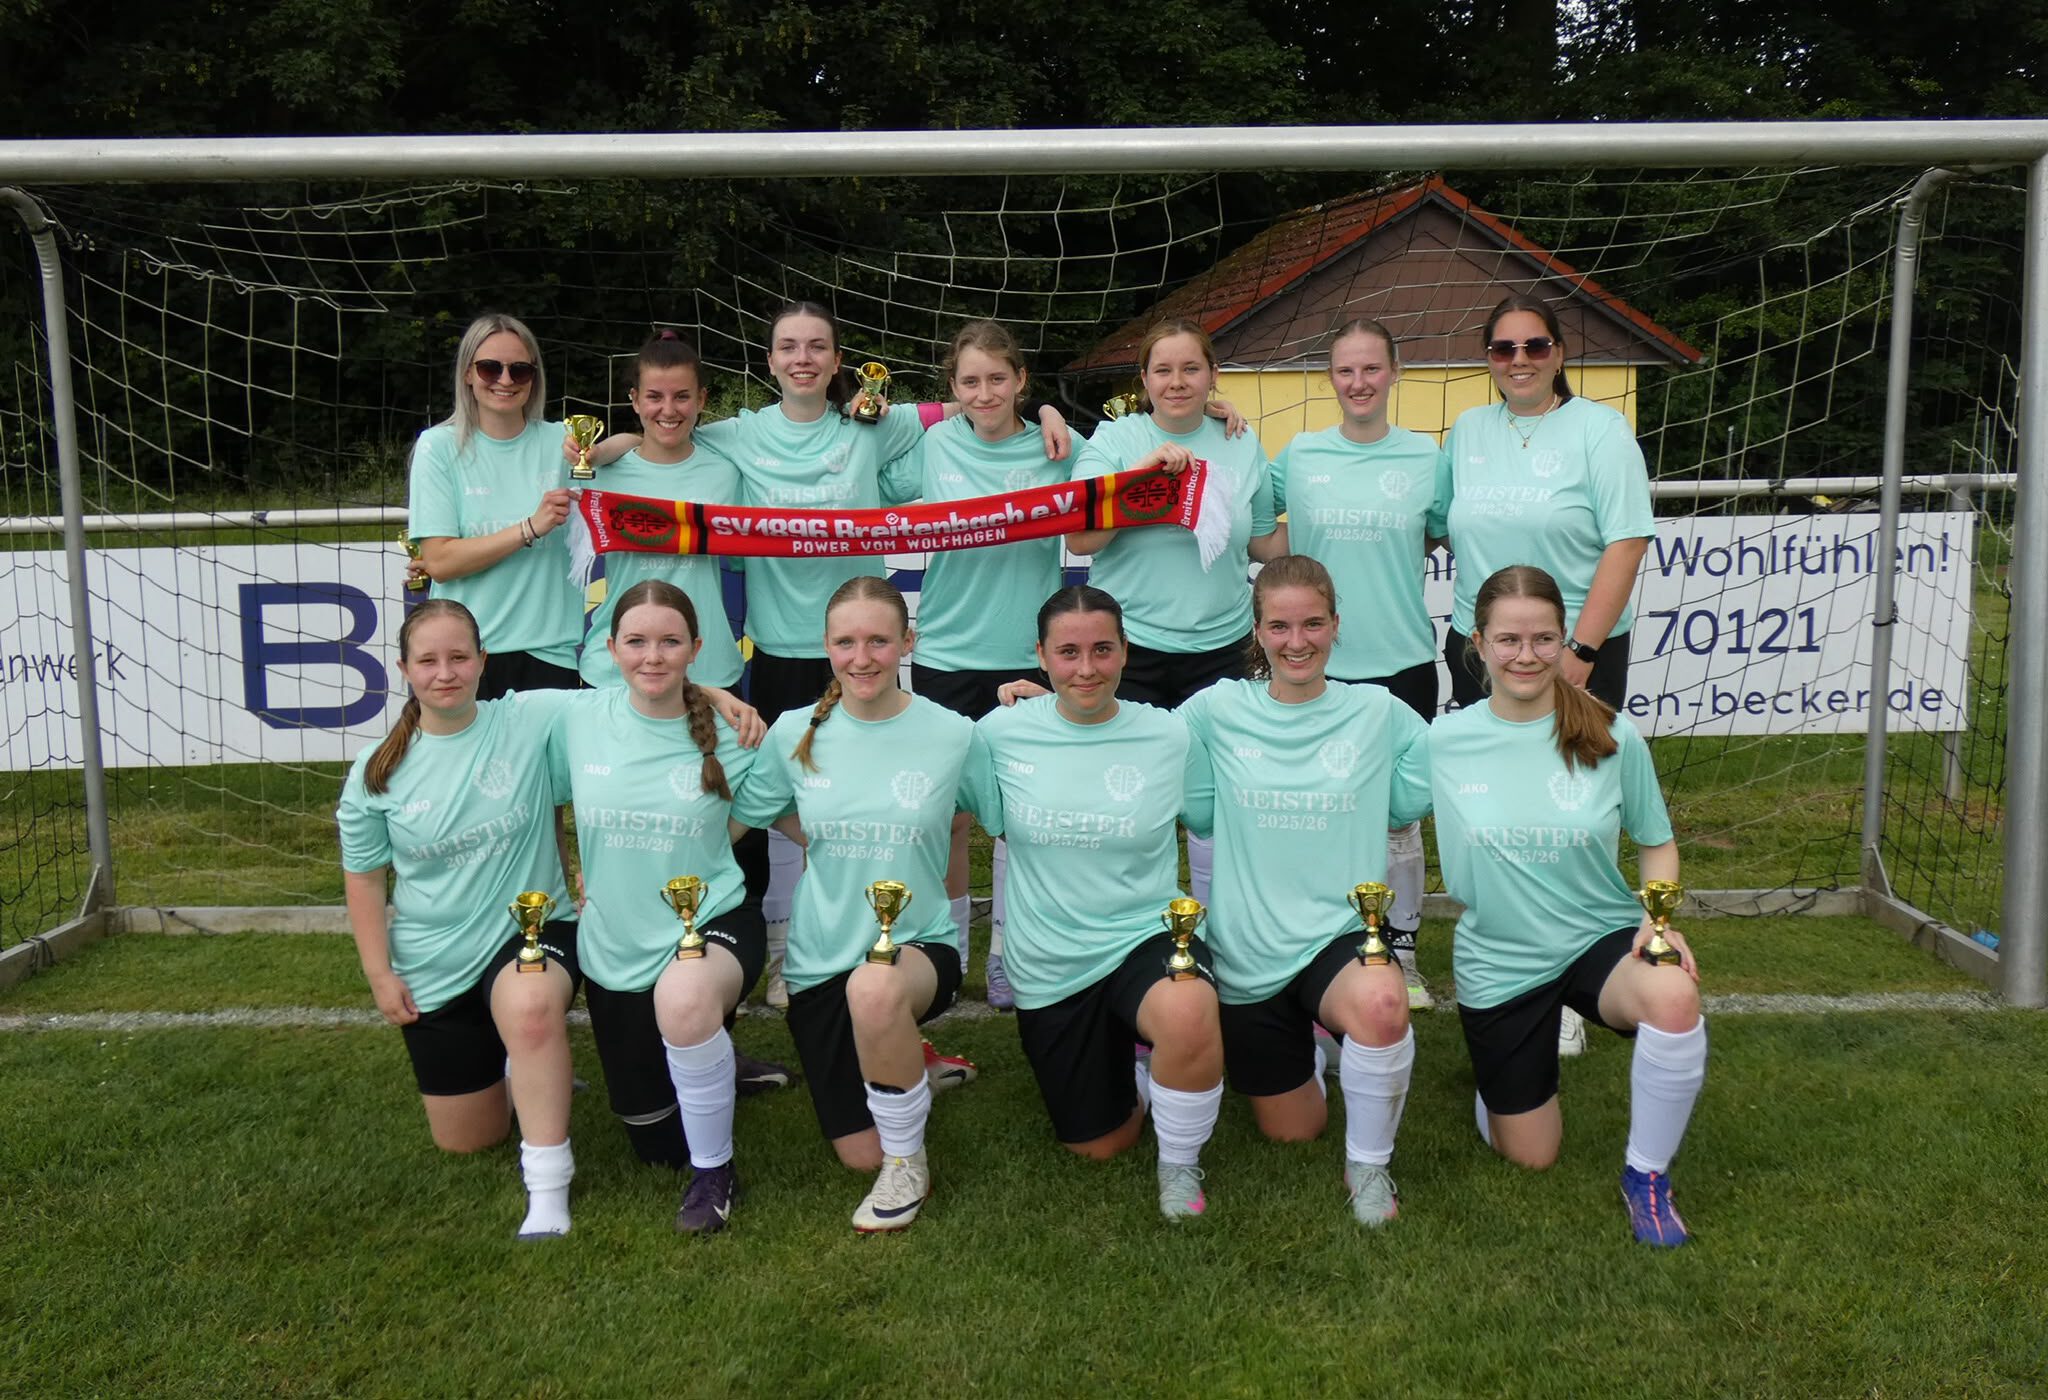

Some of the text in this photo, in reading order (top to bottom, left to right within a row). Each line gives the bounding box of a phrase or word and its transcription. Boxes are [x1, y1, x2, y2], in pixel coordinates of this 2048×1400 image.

[711, 491, 1079, 538] SV 1896 Breitenbach e.V.
[1309, 507, 1409, 530] MEISTER
[792, 527, 1007, 554] POWER VOM WOLFHAGEN
[1325, 527, 1383, 542] 2025/26
[1656, 532, 1950, 578] Wohlfühln!
[1648, 607, 1821, 656] 70121
[1627, 681, 1944, 718] en-beckerde
[802, 777, 832, 790] JAKO
[1457, 783, 1489, 795] JAKO
[1232, 787, 1359, 813] MEISTER
[408, 803, 531, 862] MEISTER
[579, 805, 707, 839] MEISTER
[808, 820, 925, 846] MEISTER
[1007, 801, 1137, 839] MEISTER
[1256, 813, 1328, 831] 2025/26
[603, 832, 675, 855] 2025/26
[1028, 830, 1101, 849] 2025/26
[1464, 825, 1593, 848] MEISTER
[443, 838, 512, 870] 2025/26
[826, 843, 895, 863] 2025/26
[705, 929, 738, 945] JAKO
